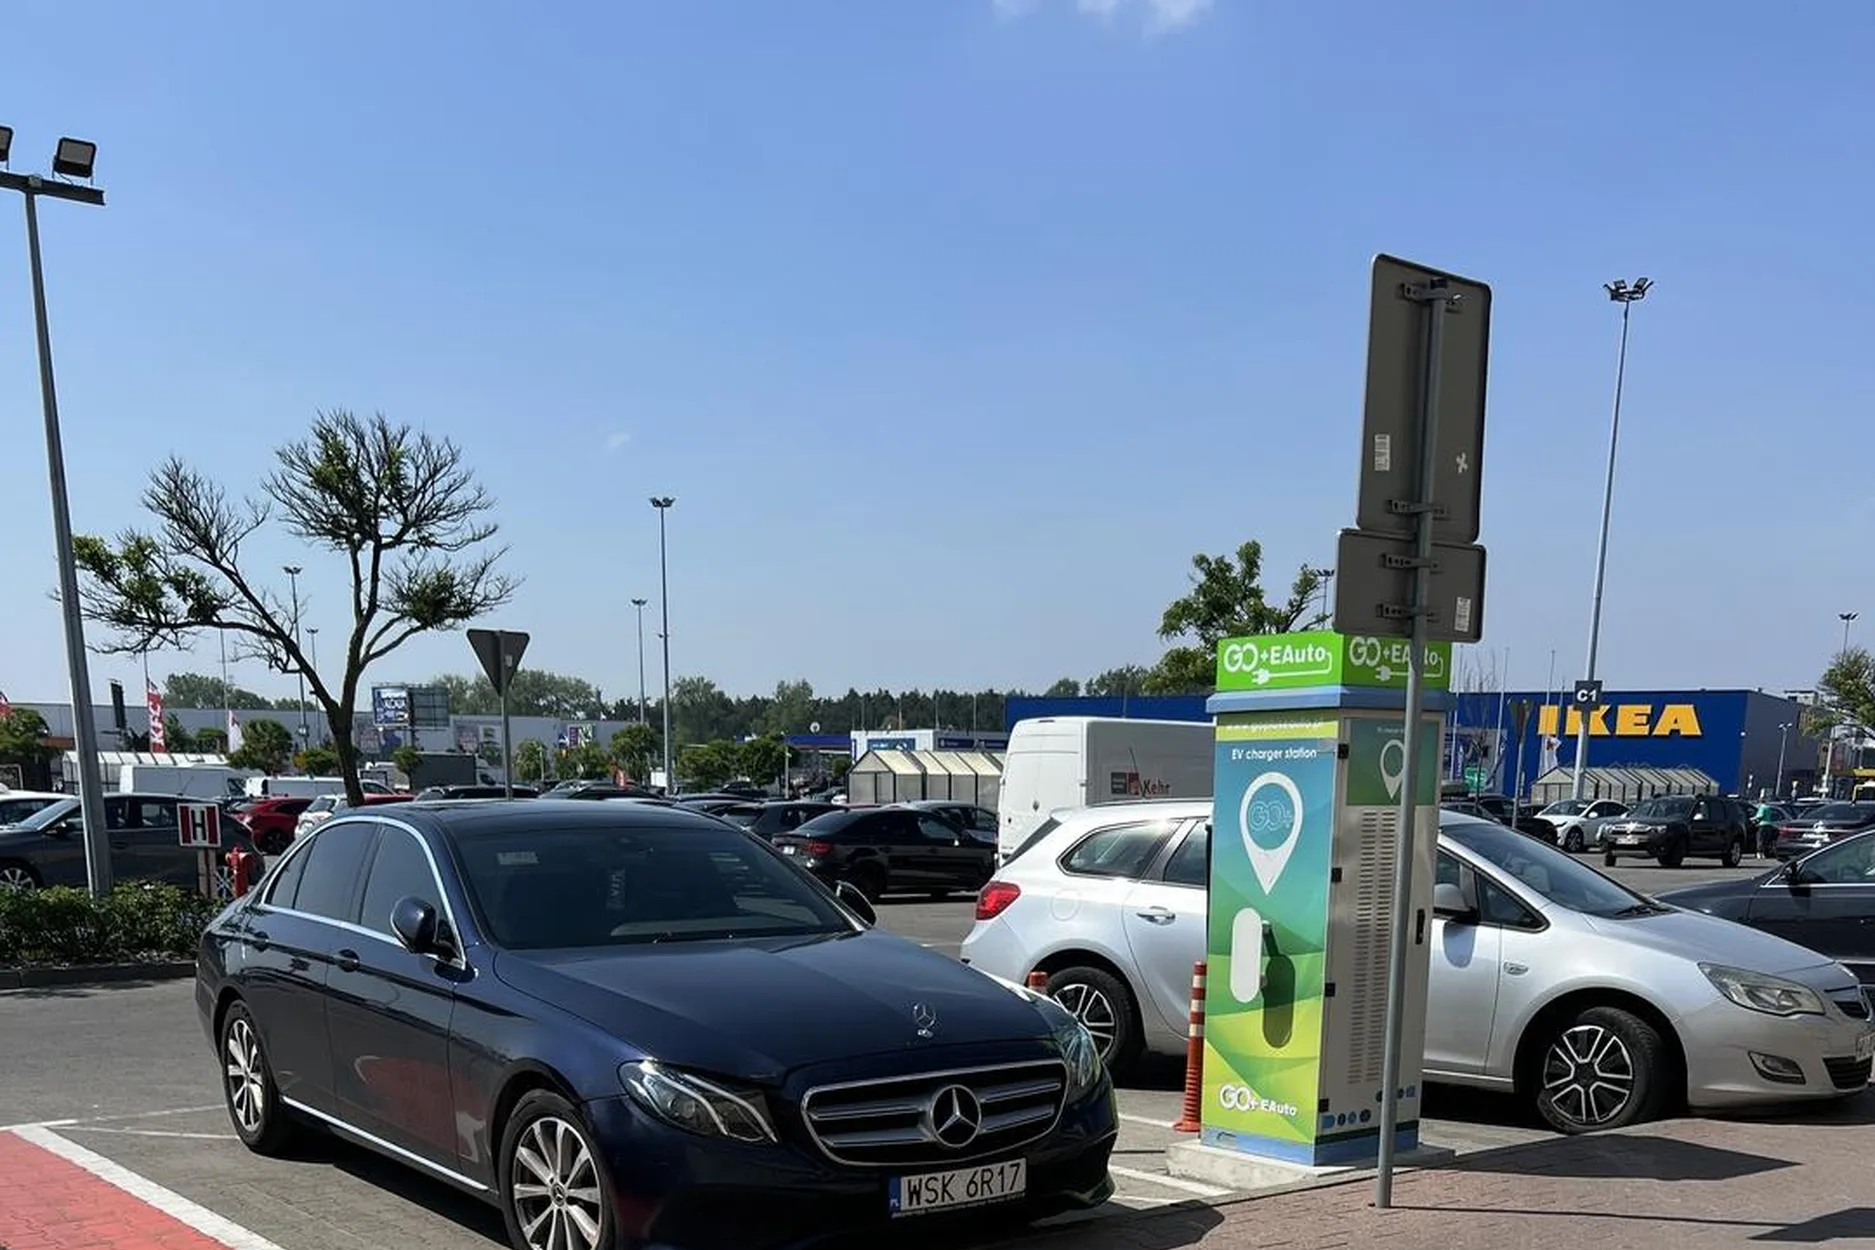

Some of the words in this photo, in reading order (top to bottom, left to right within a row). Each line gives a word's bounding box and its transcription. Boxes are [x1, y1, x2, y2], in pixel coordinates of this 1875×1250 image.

[1577, 690, 1597, 702] C1
[1538, 704, 1701, 735] IKEA
[1231, 748, 1244, 760] EV
[1246, 748, 1283, 762] charger
[1284, 746, 1317, 759] station
[191, 809, 207, 841] H
[907, 1174, 956, 1206] WSK
[966, 1162, 1021, 1198] 6R17
